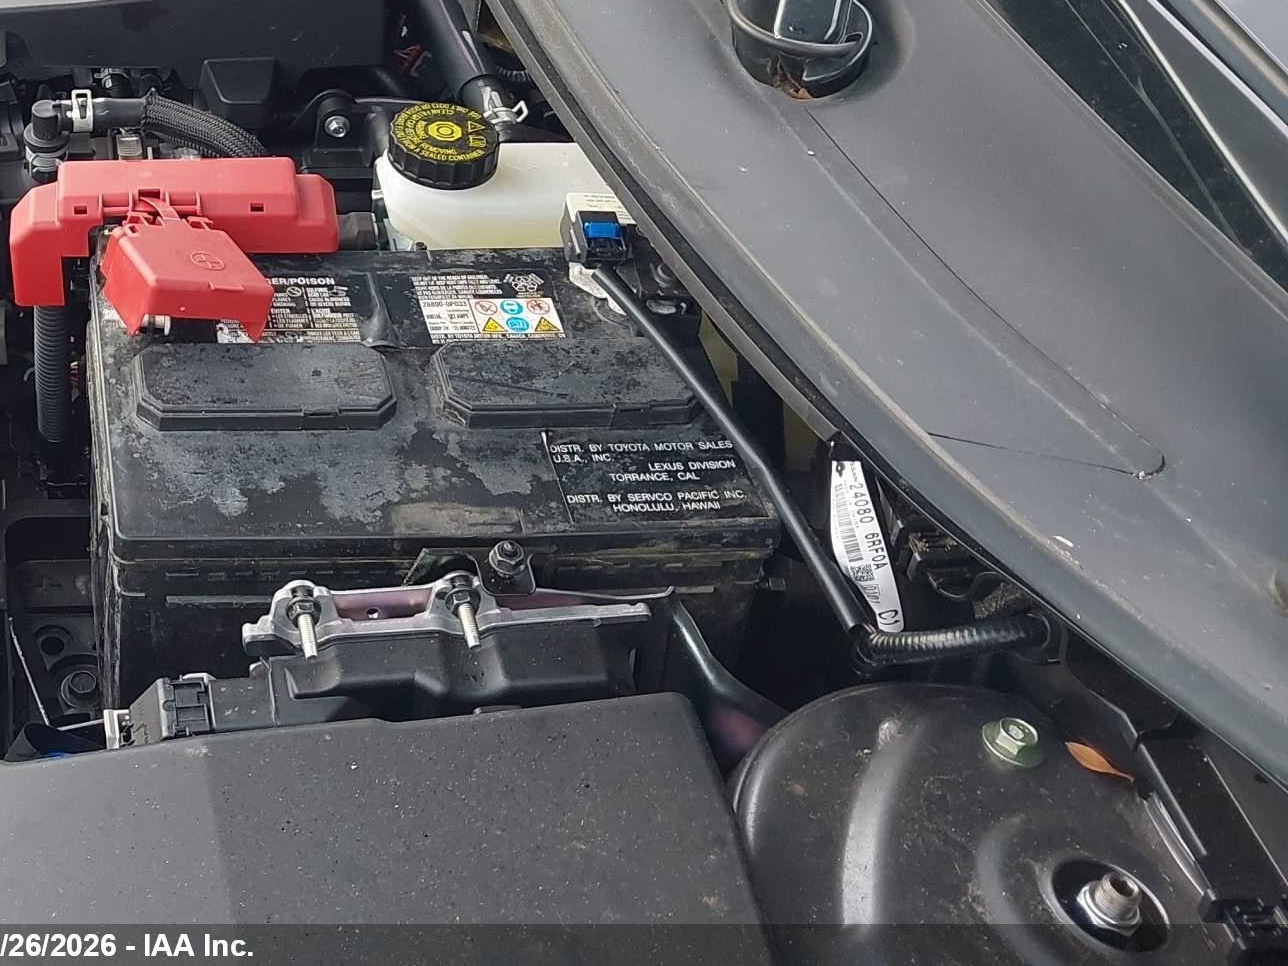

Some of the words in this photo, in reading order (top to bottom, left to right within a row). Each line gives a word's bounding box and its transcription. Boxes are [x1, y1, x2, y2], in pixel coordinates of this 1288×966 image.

[550, 444, 584, 453] DISTR.
[589, 444, 602, 452] BY
[608, 443, 650, 452] TOYOTA
[654, 442, 694, 451] MOTOR
[698, 441, 733, 450] SALES
[592, 454, 615, 462] INC.
[648, 462, 684, 471] LEXUS
[688, 460, 736, 470] DIVISION
[609, 473, 674, 482] TORRANCE,
[677, 472, 700, 480] CAL
[567, 495, 603, 504] DISTR.
[608, 494, 621, 502] BY
[627, 492, 672, 502] SERVCO
[678, 491, 720, 501] PACIFIC
[724, 489, 748, 499] INC.
[682, 501, 721, 510] HAWAII
[849, 482, 874, 524] 24080
